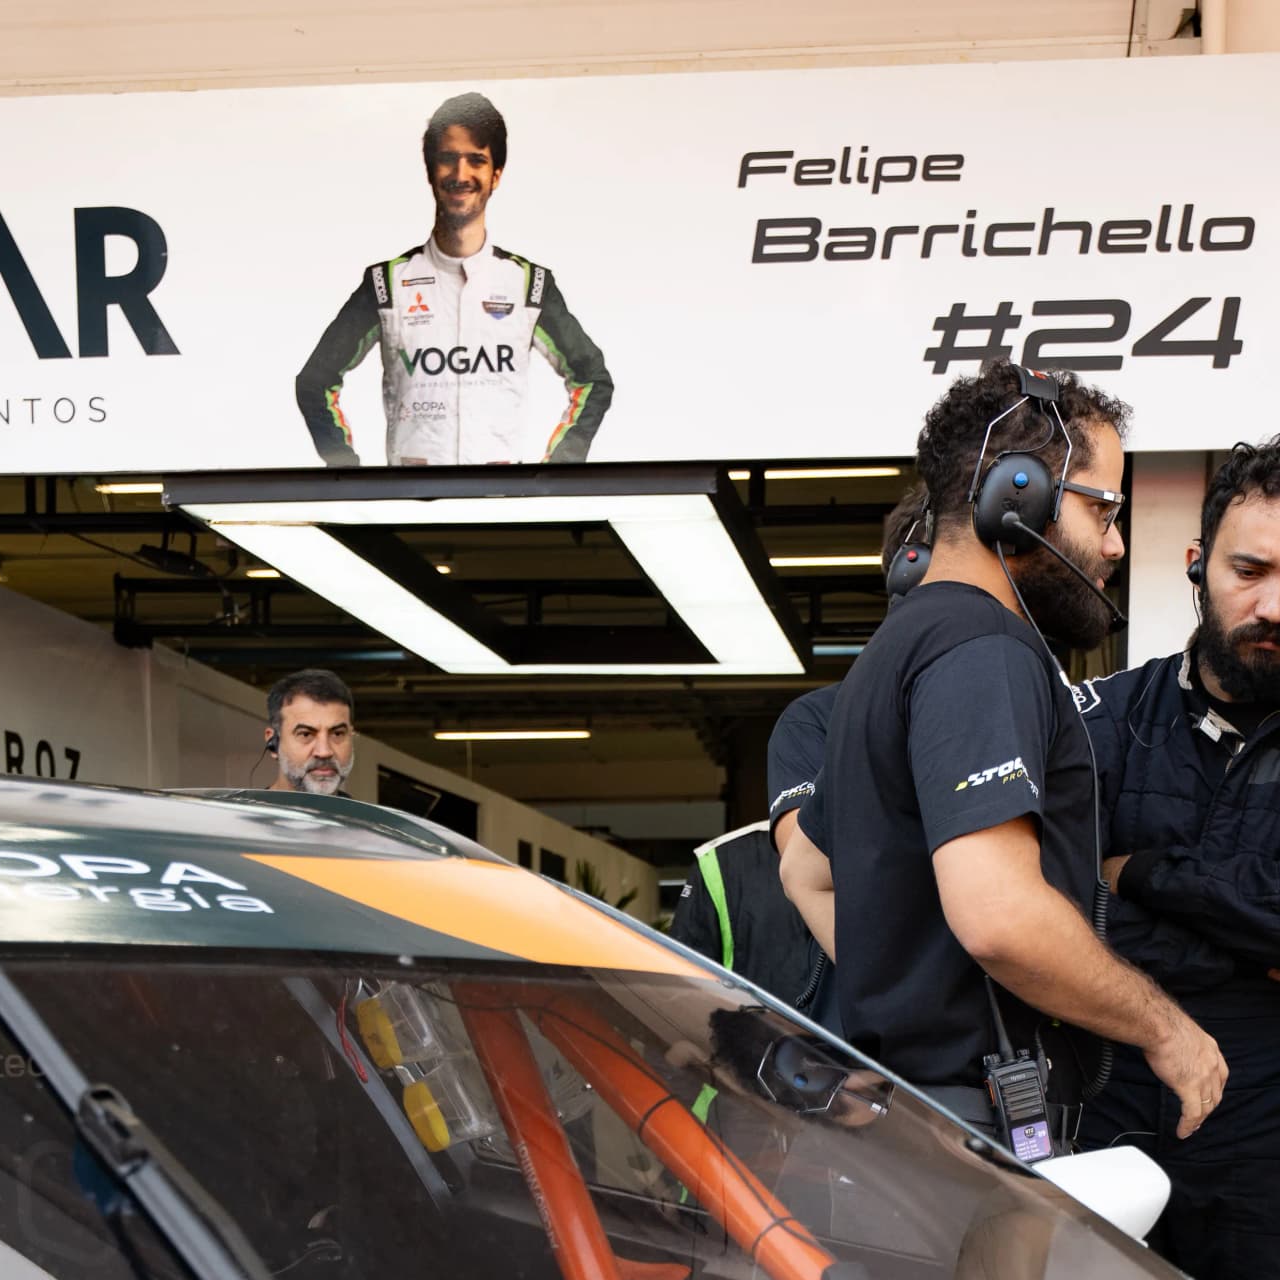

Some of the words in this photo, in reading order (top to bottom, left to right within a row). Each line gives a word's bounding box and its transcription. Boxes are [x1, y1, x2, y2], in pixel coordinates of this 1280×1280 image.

[737, 145, 965, 194] Felipe
[751, 203, 1256, 264] Barrichello
[400, 344, 515, 377] VOGAR
[923, 297, 1244, 375] #24
